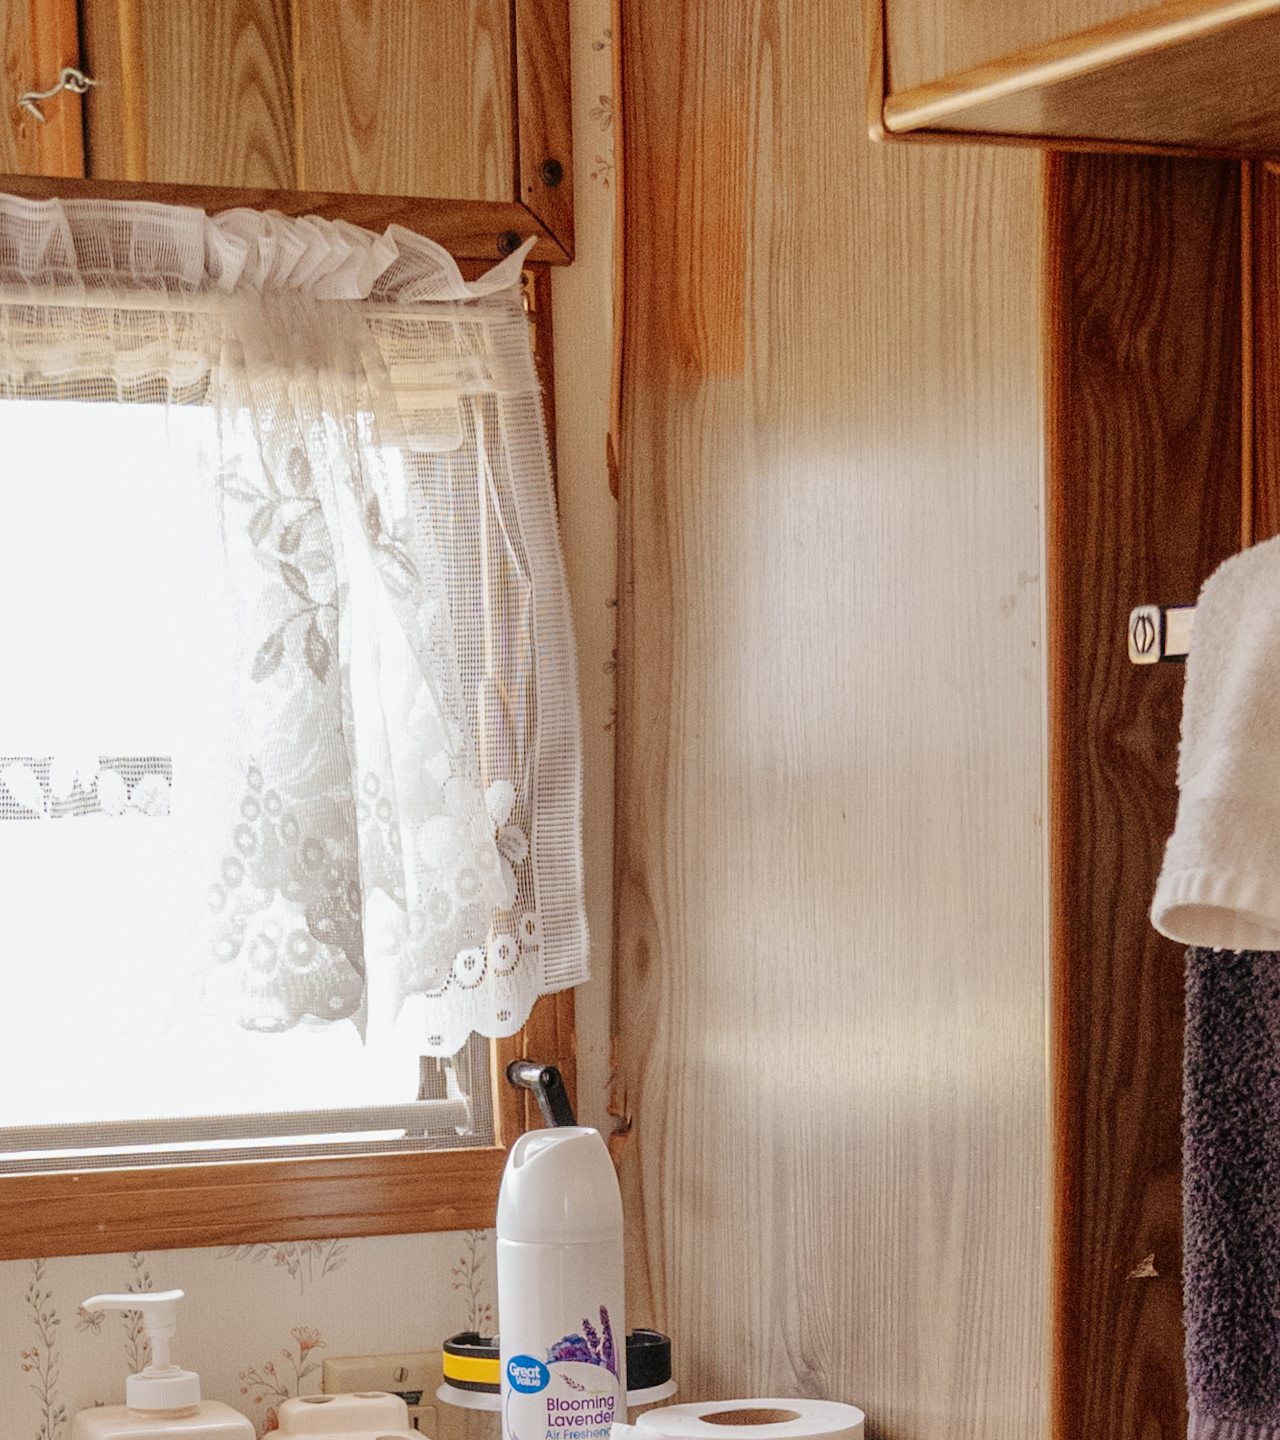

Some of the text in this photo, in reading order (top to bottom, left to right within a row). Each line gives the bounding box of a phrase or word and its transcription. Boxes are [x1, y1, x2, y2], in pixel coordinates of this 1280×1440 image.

[509, 1362, 541, 1378] Great
[516, 1375, 541, 1387] Value
[546, 1395, 615, 1411] Blooming
[547, 1411, 615, 1427] Lavender
[545, 1429, 560, 1440] Air
